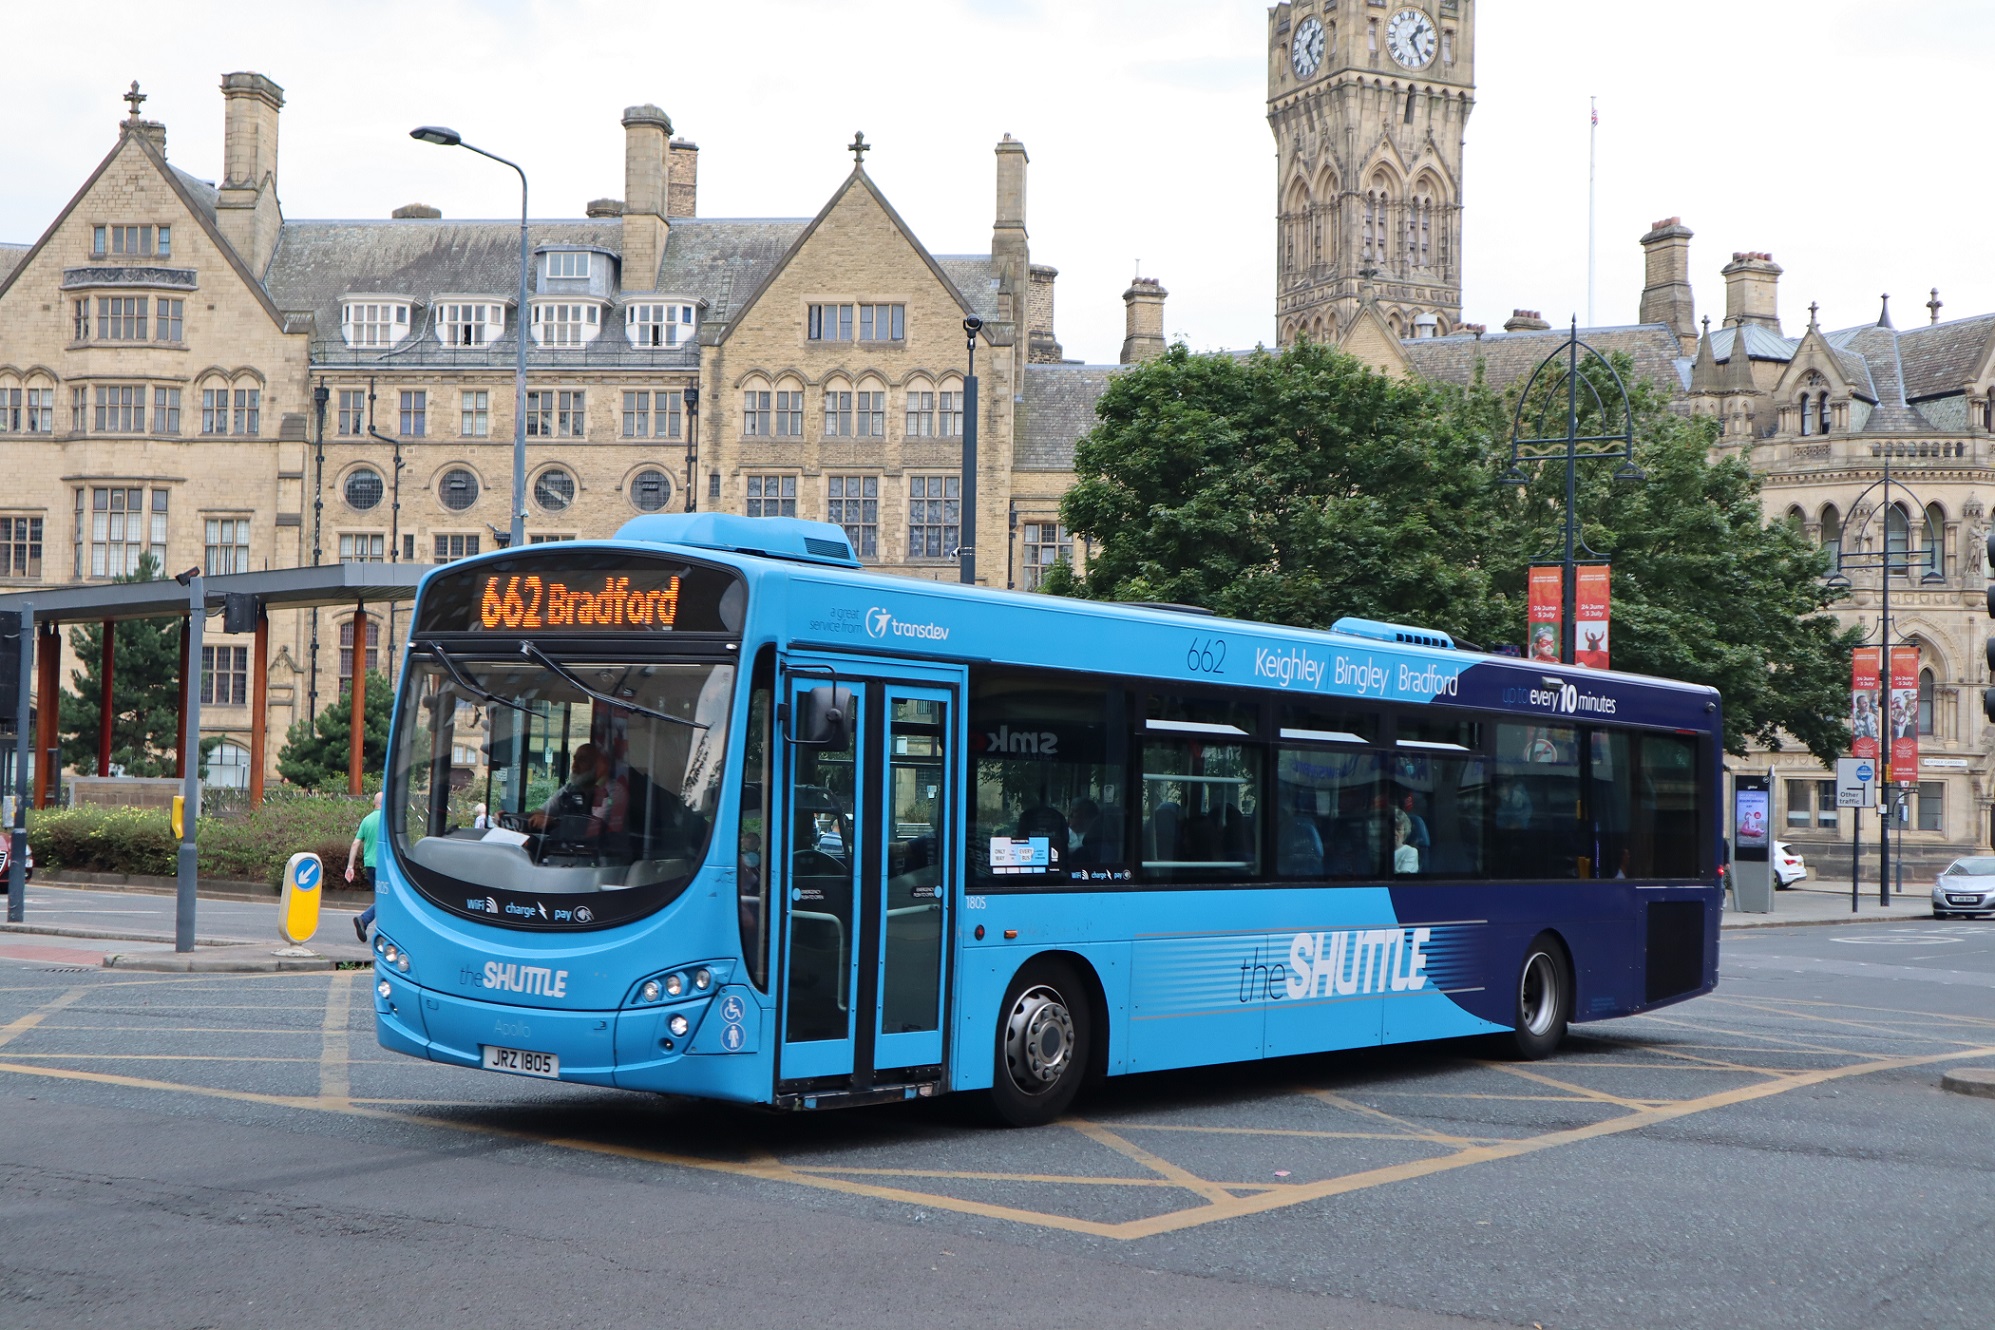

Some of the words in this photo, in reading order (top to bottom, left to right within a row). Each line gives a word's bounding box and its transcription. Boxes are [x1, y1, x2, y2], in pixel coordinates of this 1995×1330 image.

[481, 576, 543, 628] 662
[547, 576, 680, 625] Bradford
[837, 607, 859, 622] great
[809, 619, 841, 632] service
[842, 621, 862, 634] from
[891, 618, 949, 640] transdev
[1186, 637, 1226, 674] 662
[1255, 646, 1324, 689] Keighley
[1334, 655, 1390, 695] Bingley
[1398, 663, 1459, 697] Bradford
[1530, 688, 1559, 712] every
[1560, 684, 1577, 713] 10
[1578, 691, 1616, 714] minutes
[1091, 871, 1107, 880] charge
[467, 898, 485, 911] WiFi
[505, 902, 536, 918] charge
[554, 908, 572, 921] pay
[965, 896, 986, 909] 1805
[492, 1049, 518, 1069] JRZ
[521, 1052, 551, 1074] 1805
